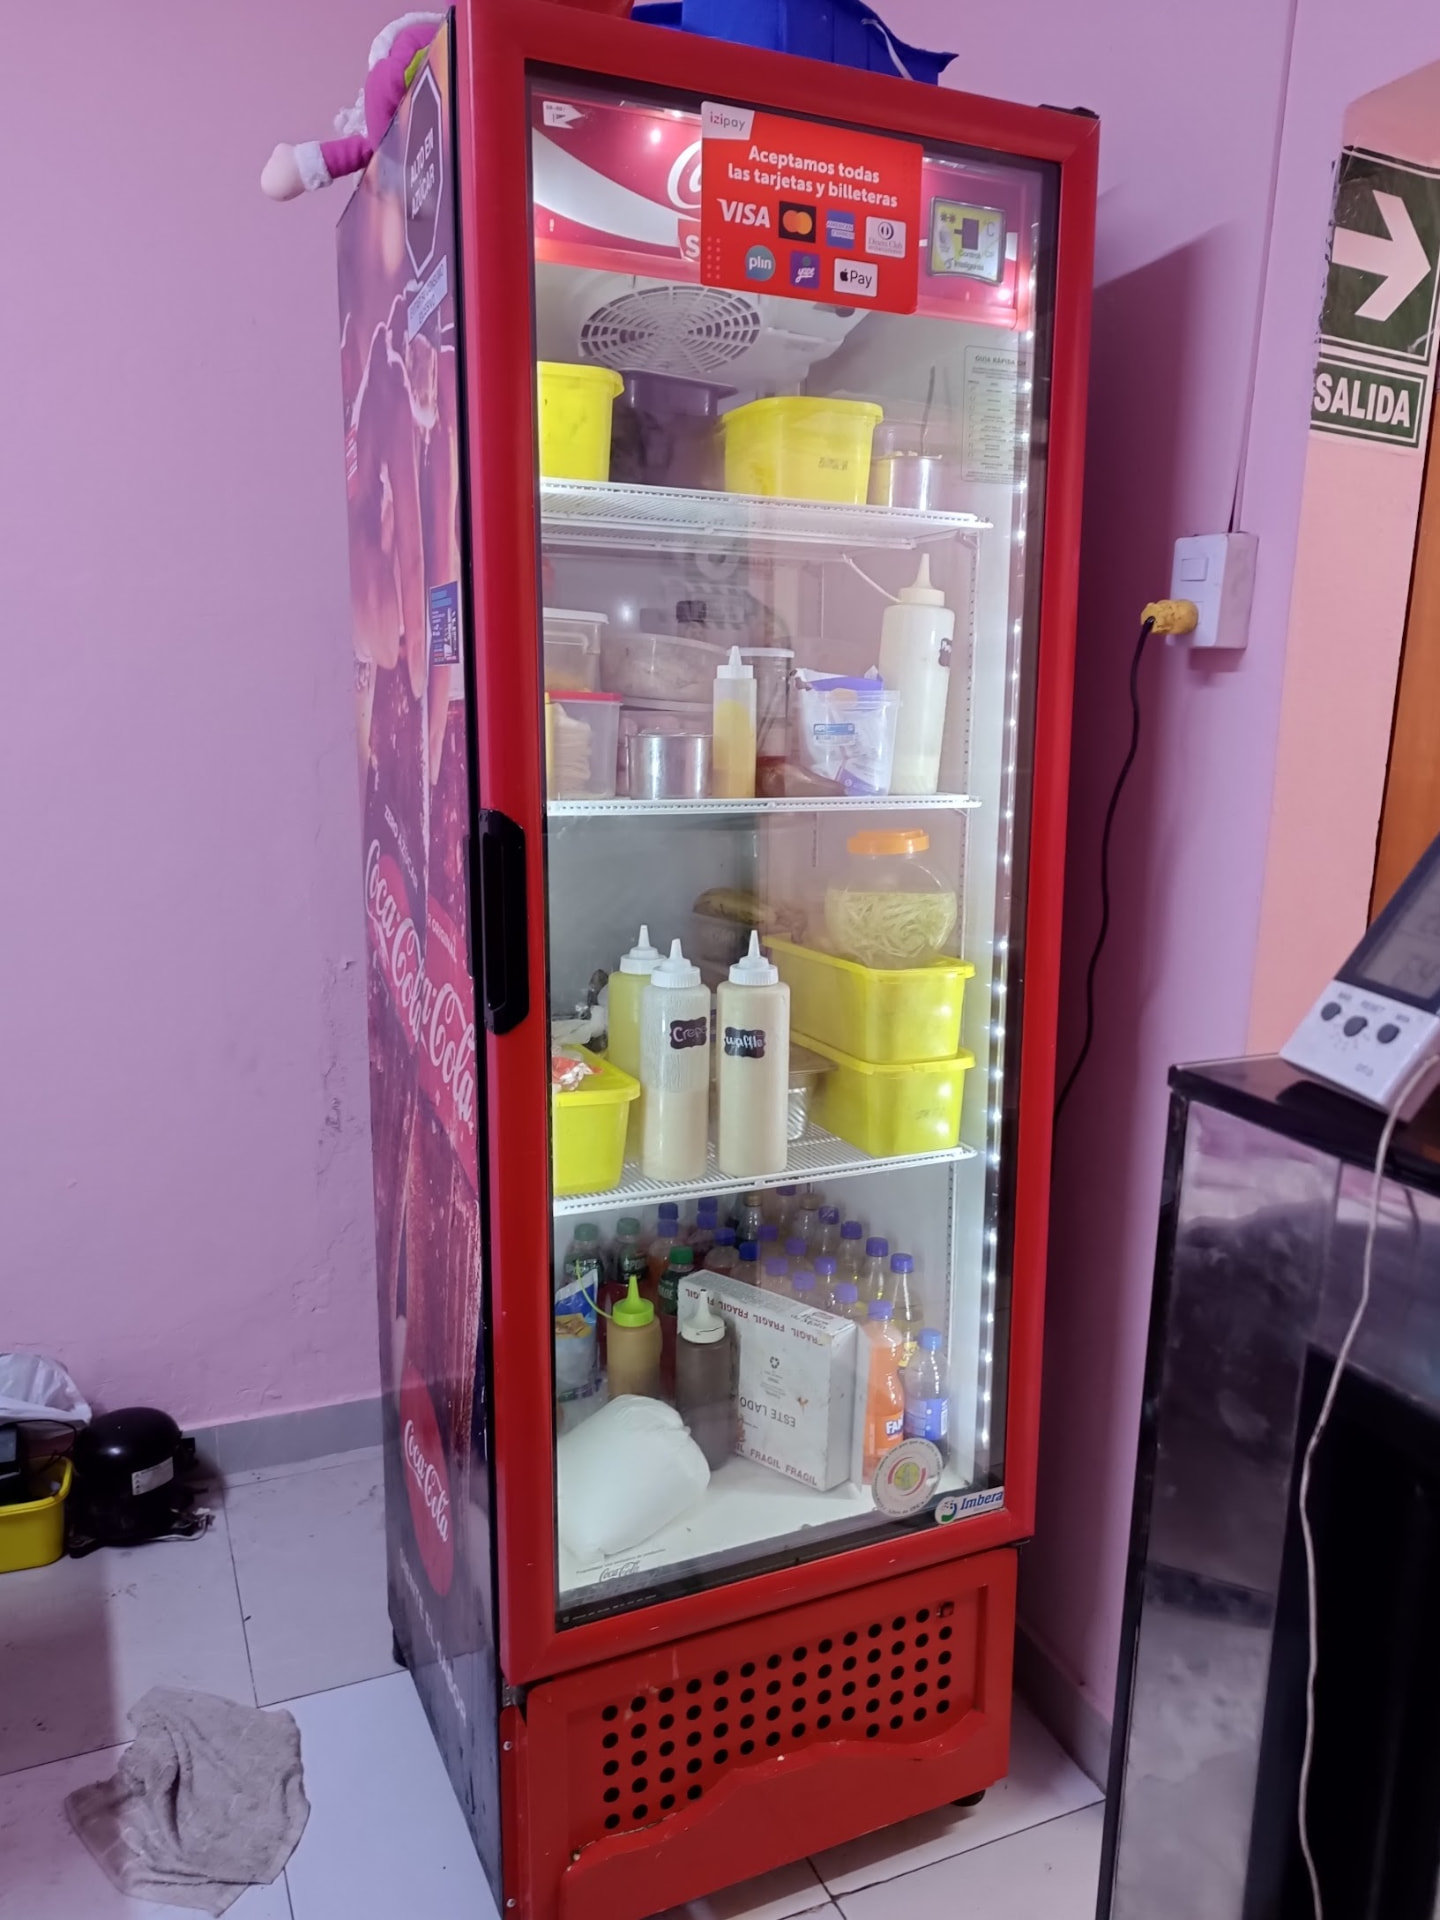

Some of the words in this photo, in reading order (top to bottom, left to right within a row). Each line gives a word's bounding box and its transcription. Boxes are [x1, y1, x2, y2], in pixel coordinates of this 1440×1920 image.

[709, 111, 747, 132] izipay
[411, 146, 424, 188] ALTO
[424, 128, 434, 160] EN
[748, 145, 835, 175] Aceptamos
[837, 162, 880, 184] todas
[728, 163, 751, 181] las
[753, 167, 813, 192] tarjetas
[815, 183, 826, 198] y
[828, 181, 898, 208] billeteras
[716, 198, 771, 228] VISA
[749, 256, 772, 271] plin
[850, 270, 873, 289] Pay
[1313, 373, 1411, 428] SALIDA
[717, 1301, 749, 1320] FRAGIL
[753, 1313, 786, 1333] FRAGIL
[739, 1396, 768, 1416] LADO
[770, 1408, 796, 1428] ESTE
[750, 1448, 781, 1470] FRAGIL
[785, 1464, 818, 1487] FRAGIL
[404, 1419, 450, 1542] Coca-Cola
[960, 1491, 1004, 1511] Imbera
